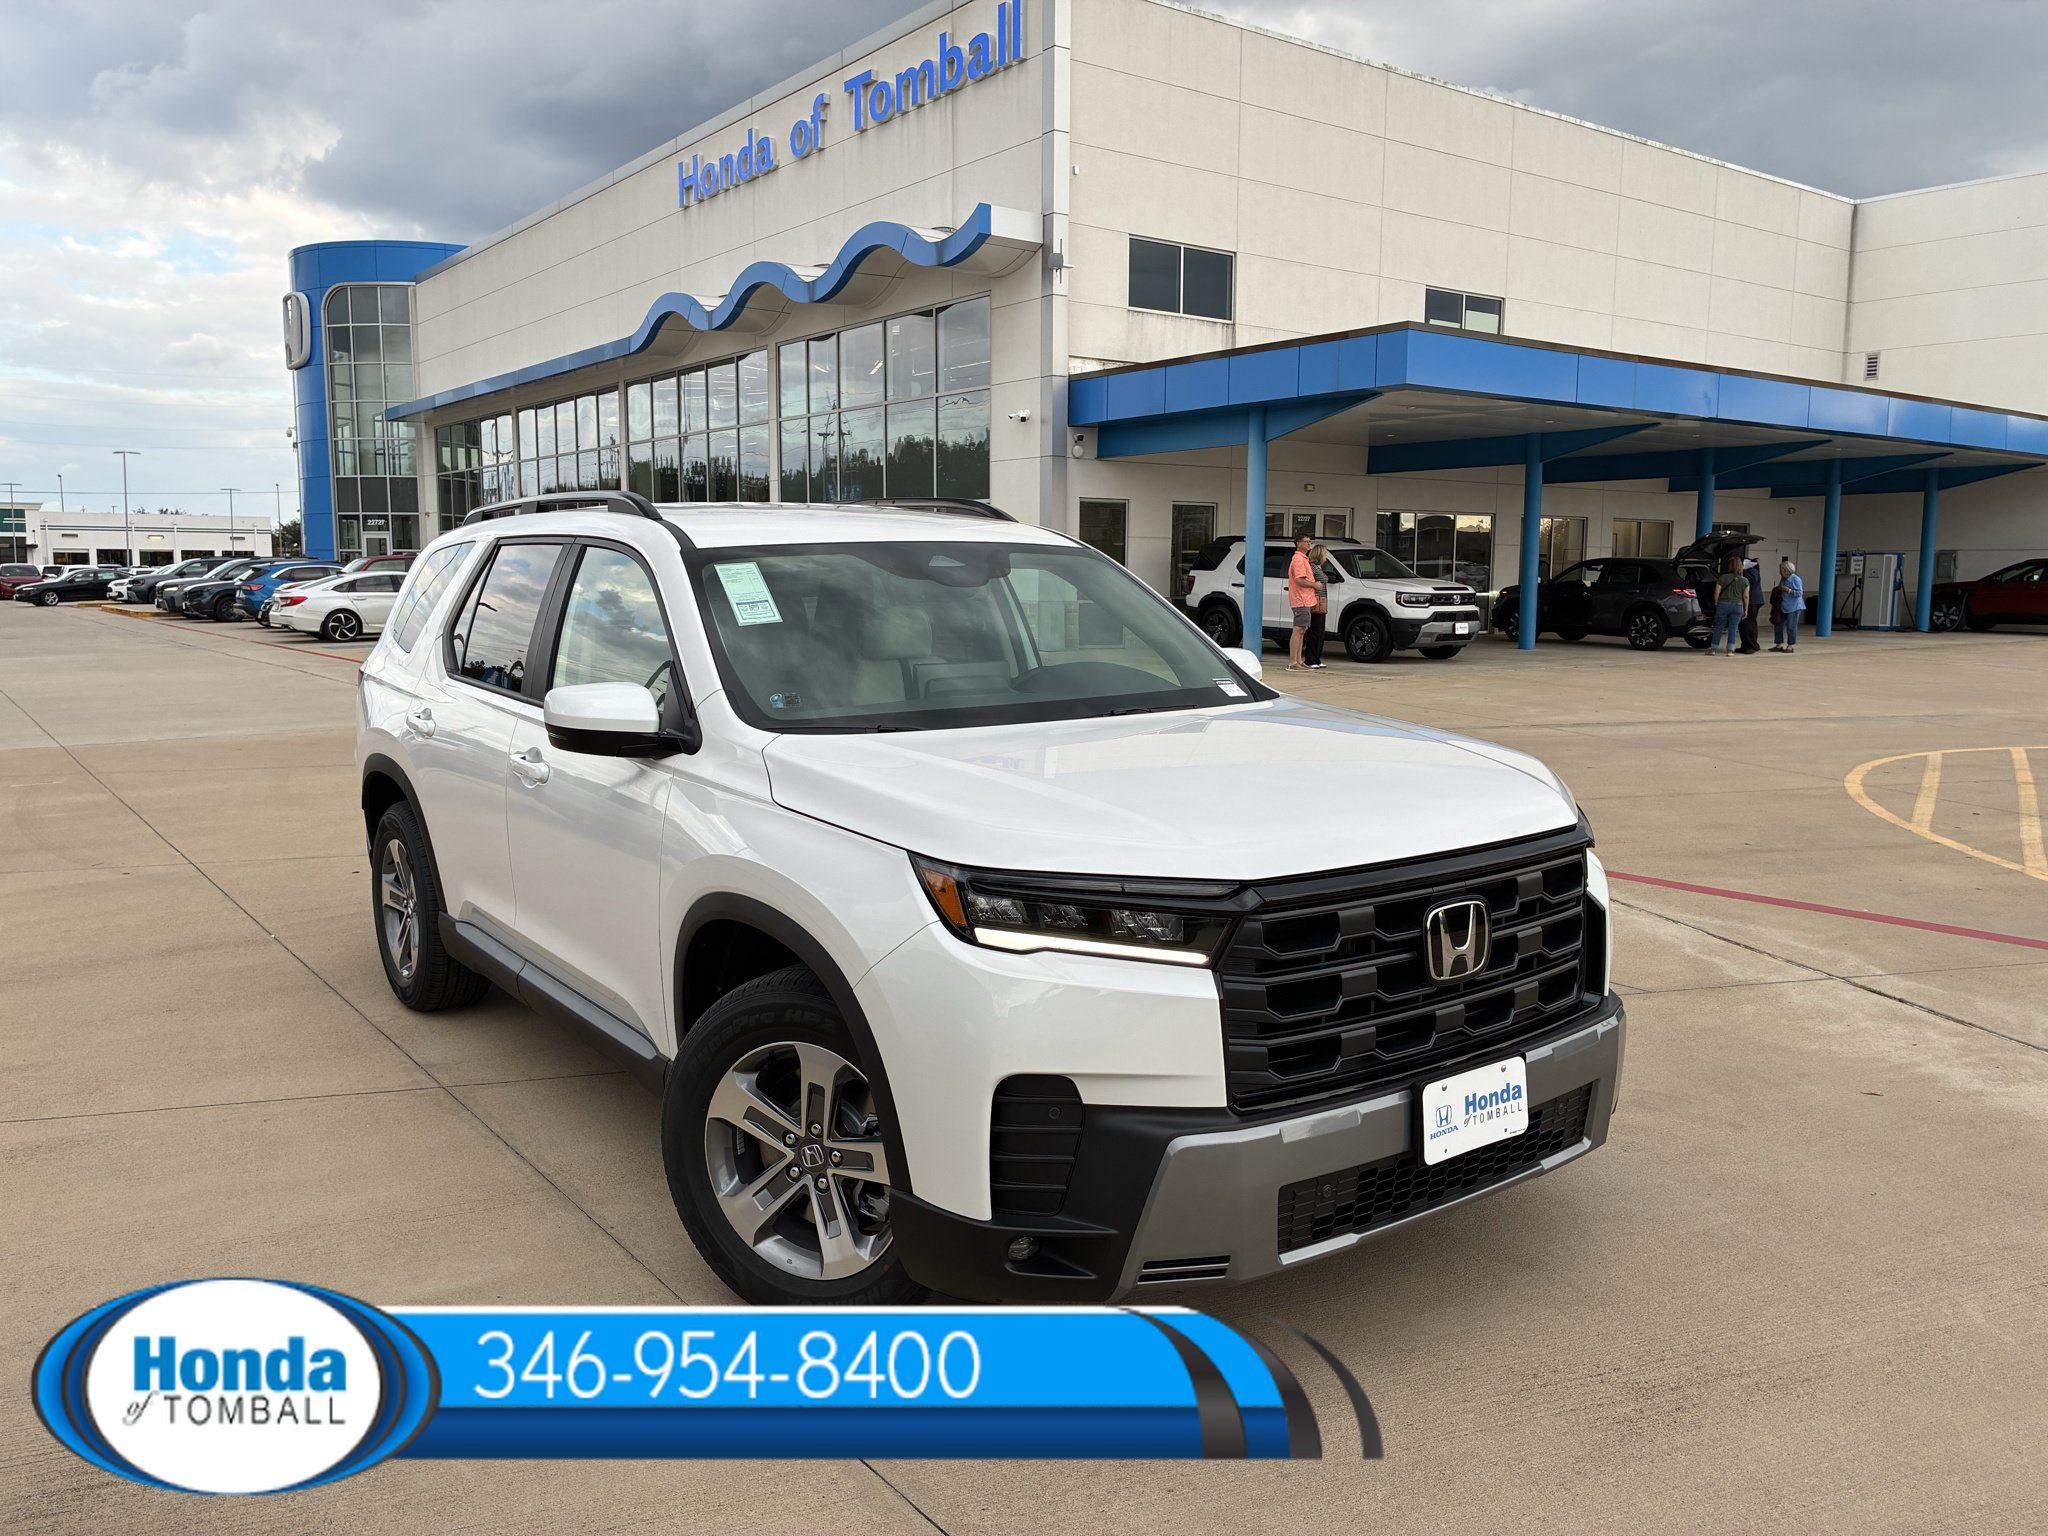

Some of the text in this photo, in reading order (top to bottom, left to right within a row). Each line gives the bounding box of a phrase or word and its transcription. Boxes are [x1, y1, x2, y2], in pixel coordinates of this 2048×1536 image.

[678, 0, 1028, 208] Honda of Tomball
[1464, 1083, 1522, 1115] Honda
[1464, 1102, 1522, 1128] of TOMBALL
[1430, 1125, 1459, 1140] HONDA
